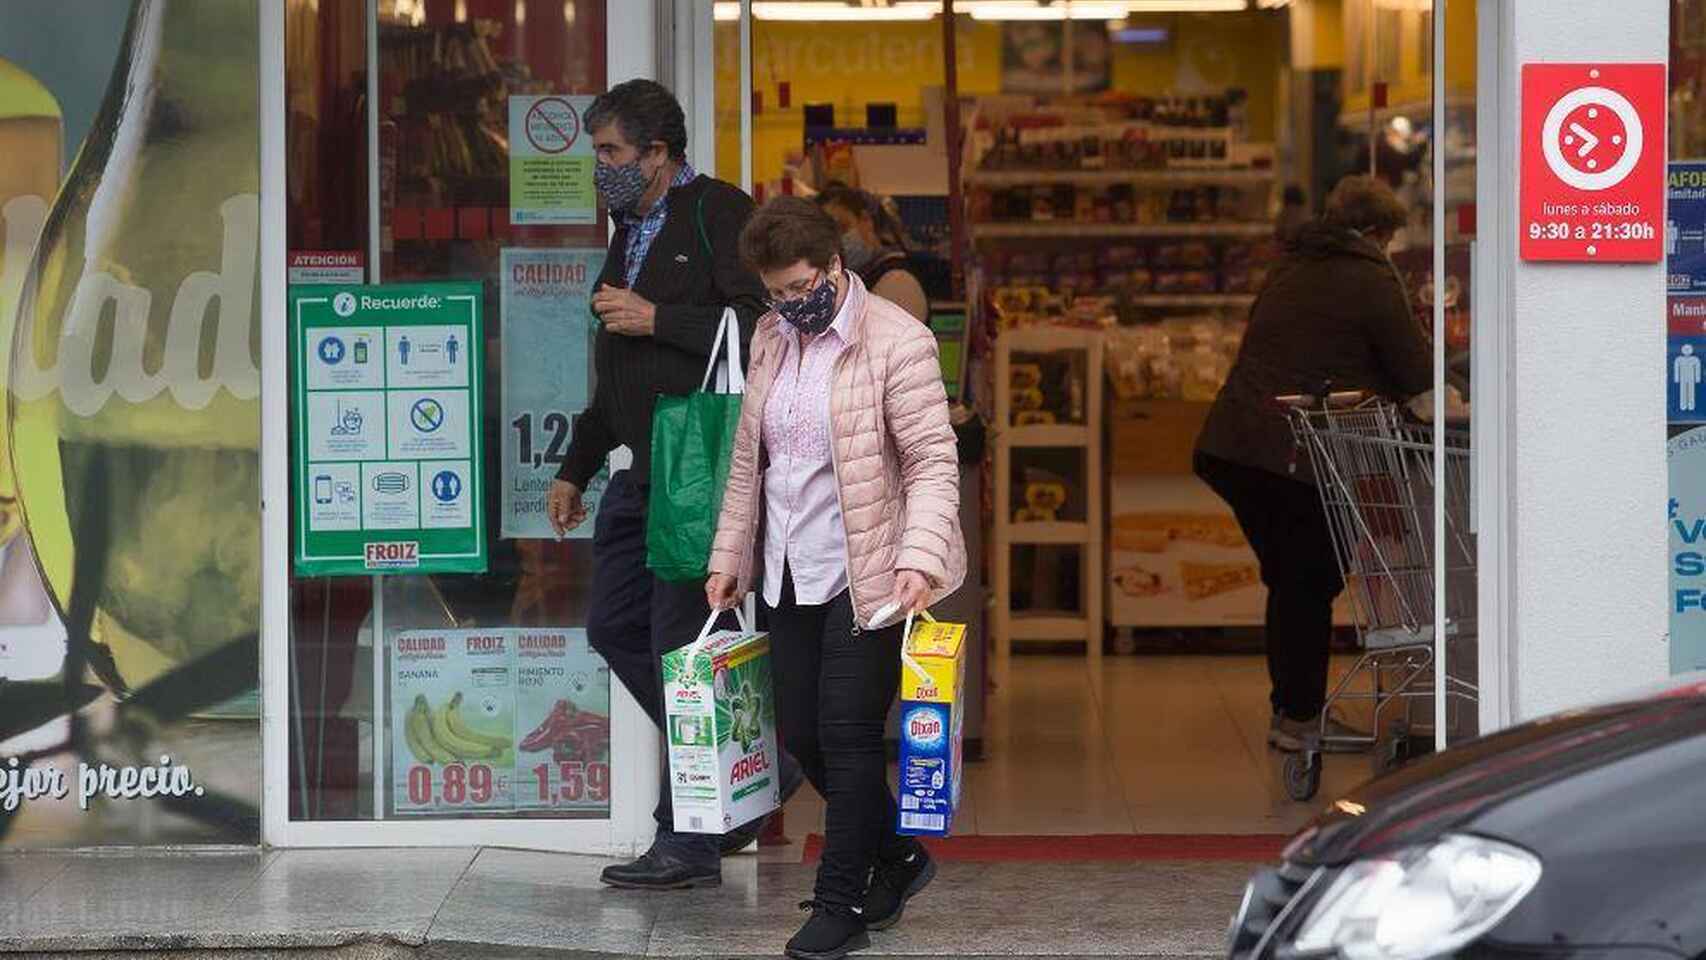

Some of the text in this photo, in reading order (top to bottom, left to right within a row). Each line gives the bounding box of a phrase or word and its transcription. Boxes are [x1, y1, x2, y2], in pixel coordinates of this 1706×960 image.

[1543, 202, 1640, 215] lunes a sábado
[1529, 222, 1655, 239] 9:30 a 21:30h
[361, 293, 442, 311] Recuerde:
[512, 412, 581, 469] 1,2
[366, 542, 417, 560] FROIZ
[398, 636, 445, 652] CALIDAD
[465, 636, 504, 651] FROIZ
[911, 720, 940, 737] Dixan
[730, 751, 770, 785] ARIEL
[79, 754, 205, 811] precio.
[408, 763, 493, 806] 0,89
[530, 760, 610, 805] 1,59
